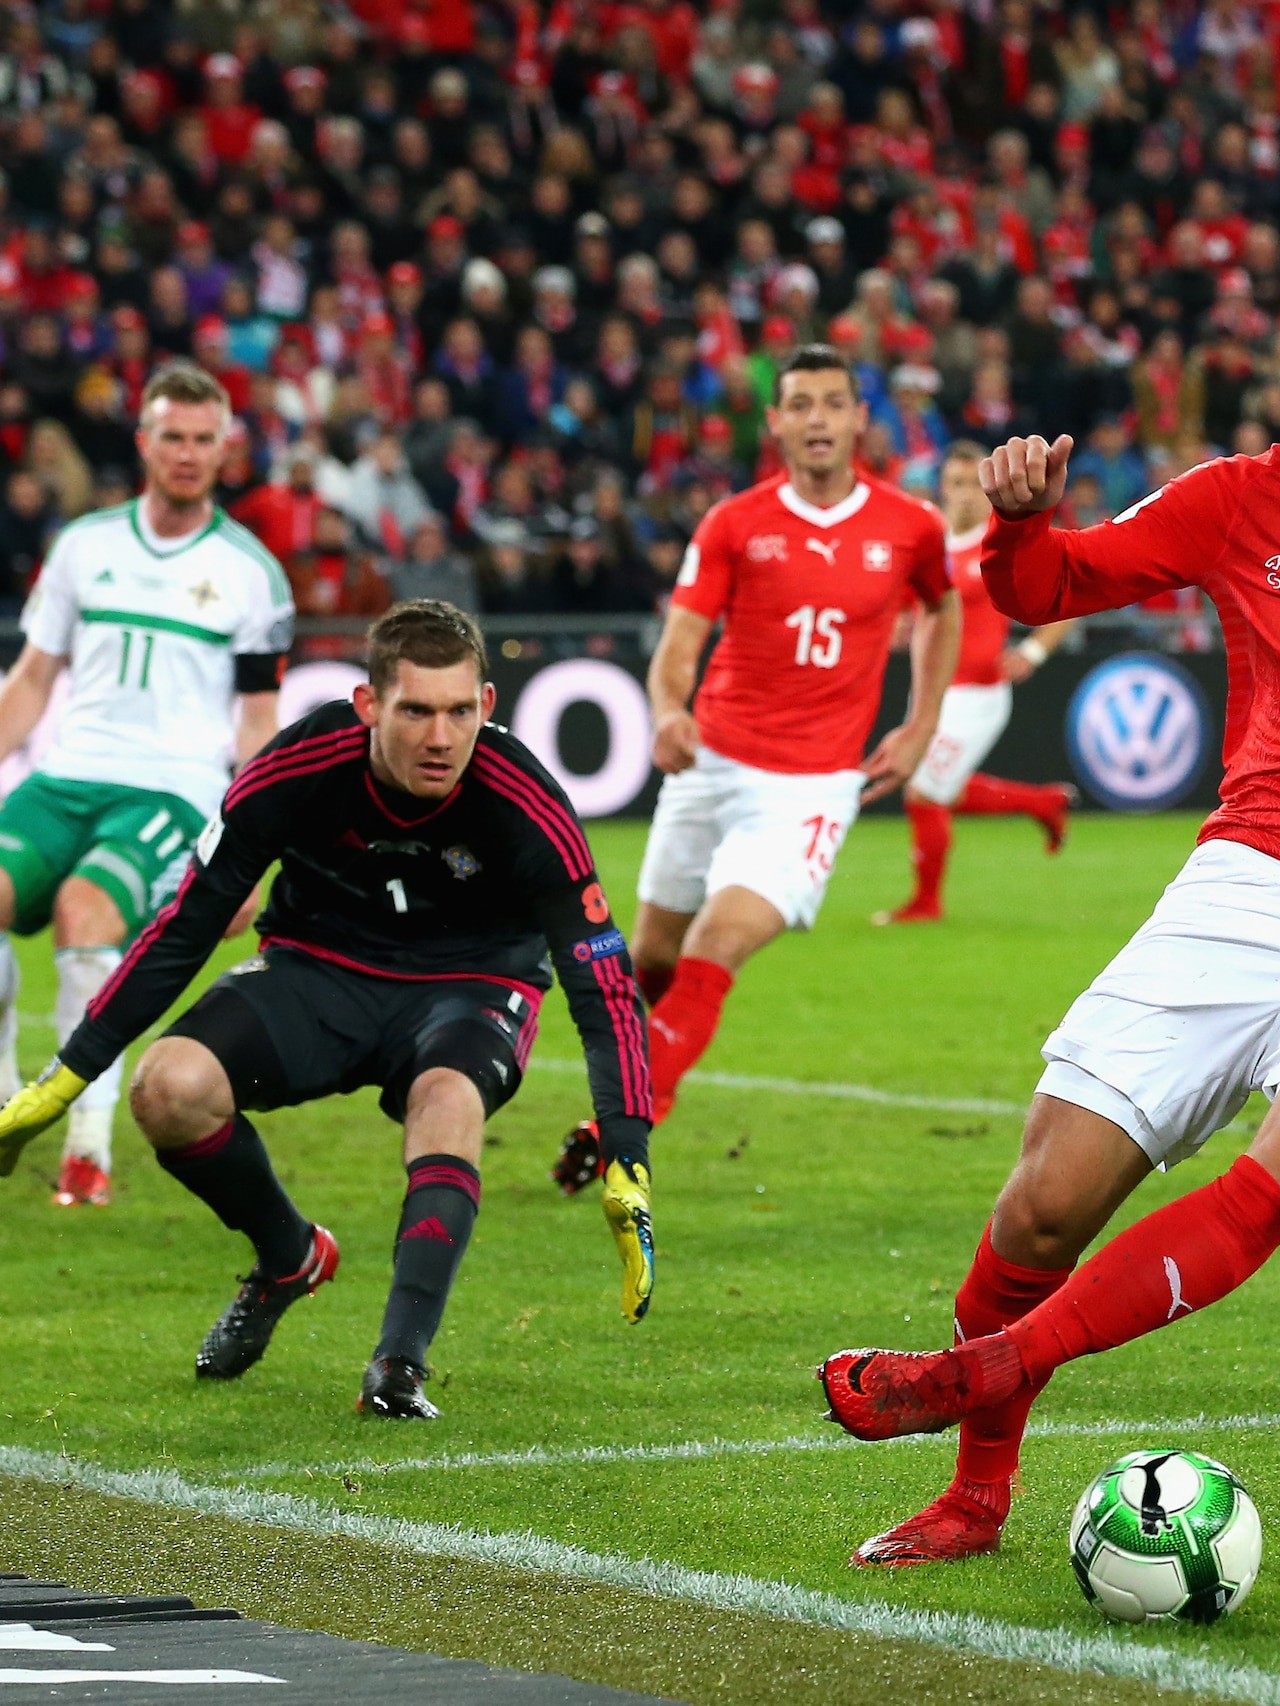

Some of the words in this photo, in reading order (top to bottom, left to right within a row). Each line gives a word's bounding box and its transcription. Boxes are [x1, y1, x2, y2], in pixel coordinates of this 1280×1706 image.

[118, 630, 154, 689] 11
[785, 604, 847, 669] 15
[138, 808, 184, 859] 11
[386, 878, 408, 913] 1
